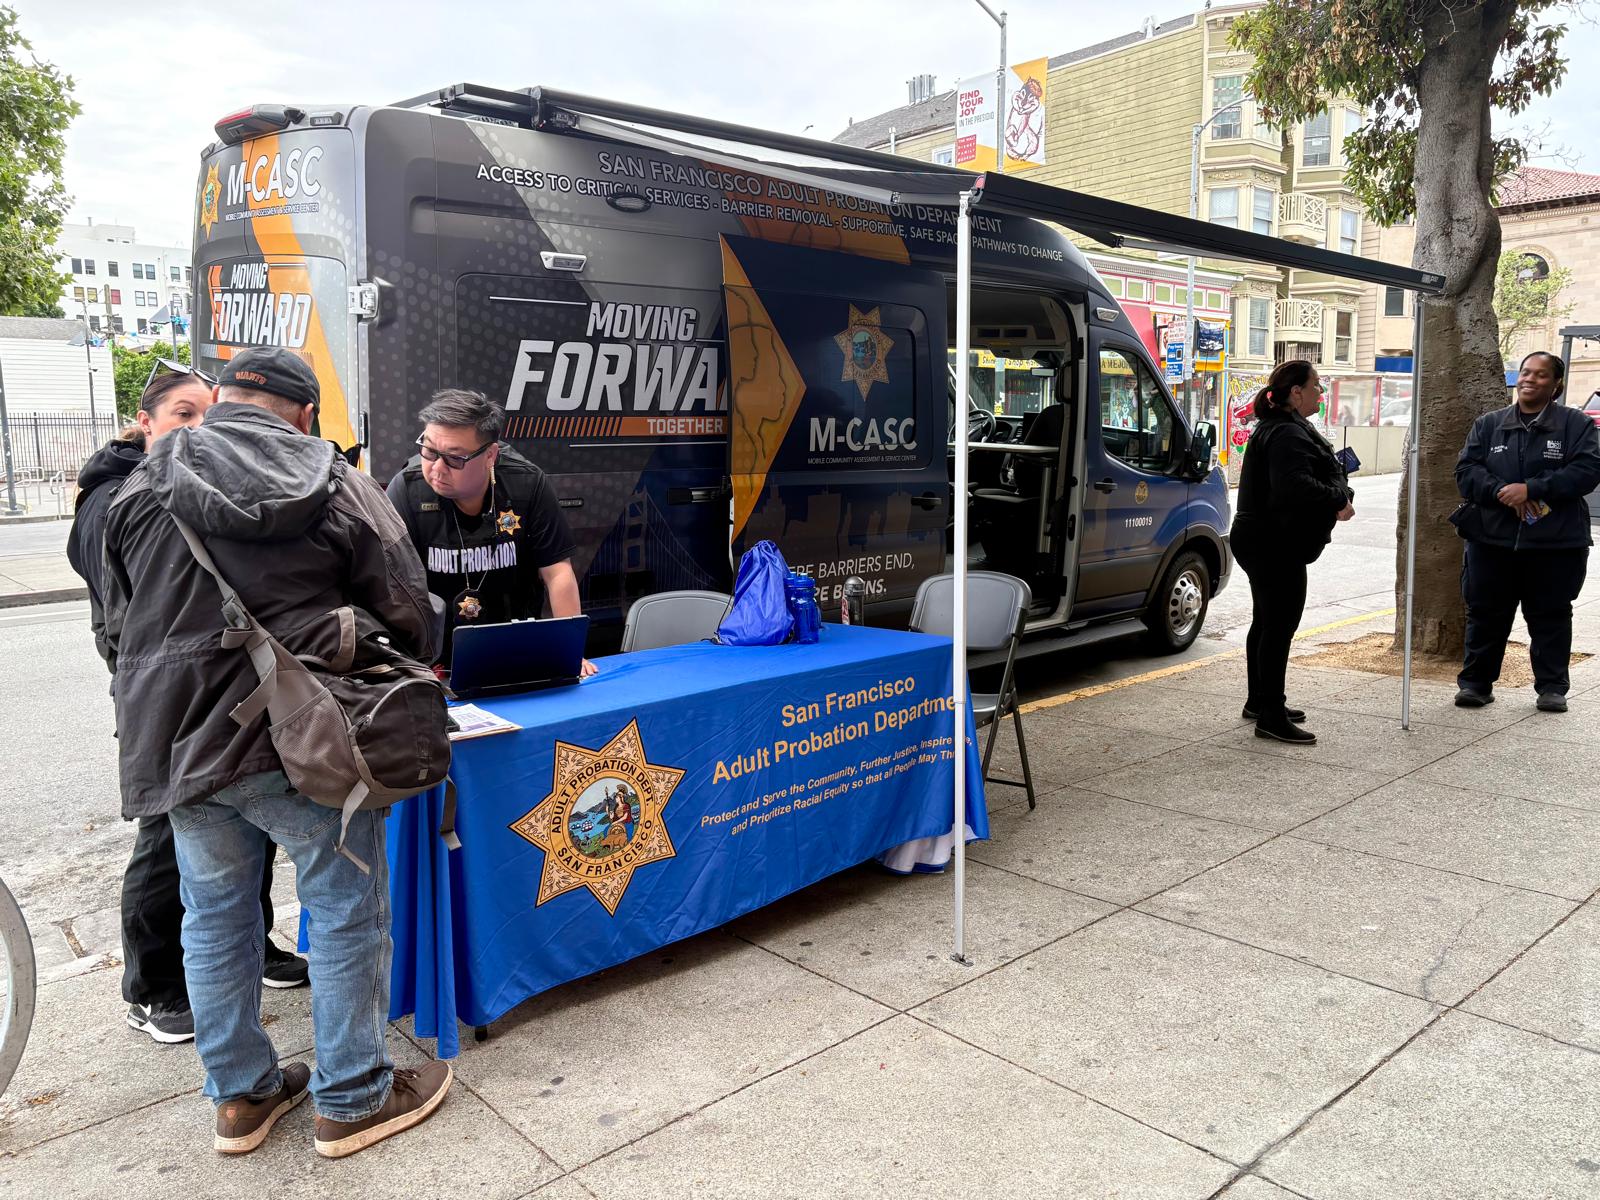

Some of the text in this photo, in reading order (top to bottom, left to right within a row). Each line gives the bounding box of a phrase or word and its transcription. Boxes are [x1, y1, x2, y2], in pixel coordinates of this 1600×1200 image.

[959, 89, 980, 101] FIND
[959, 97, 983, 109] YOUR
[959, 107, 976, 118] JOY
[966, 117, 974, 126] THE
[226, 146, 324, 206] M-CASC
[599, 152, 1002, 233] SAN FRANCISCO ADULT PROBATION DEPARMENT
[477, 163, 544, 188] ACCESS
[547, 173, 572, 192] TO
[645, 187, 709, 209] SERVICES
[721, 198, 773, 219] BARRIER
[777, 207, 833, 227] REMOVAL
[842, 216, 908, 239] SUPPORTIVE,
[910, 226, 934, 242] SAFE
[936, 229, 958, 246] SPAC
[972, 235, 1016, 254] PATHWAYS
[1018, 243, 1030, 256] TO
[1030, 246, 1064, 262] CHANGE
[230, 262, 269, 290] MOVING
[209, 292, 312, 348] FORWARD
[585, 301, 698, 342] MOVING
[504, 339, 728, 411] FORWA
[647, 417, 724, 434] TOGETHER
[809, 416, 918, 452] M-CASC
[1125, 515, 1153, 528] 11100019
[427, 540, 517, 574] ADULT PROBATION
[818, 555, 882, 579] BARRIERS
[885, 552, 915, 571] END,
[781, 676, 916, 727] San Francisco
[712, 694, 956, 785] Adult Probation Departme
[551, 759, 654, 834] ADULT PROBATION DEPT.
[701, 807, 741, 828] Protect
[741, 796, 760, 814] and
[762, 788, 788, 807] Serve
[789, 783, 805, 795] the
[807, 765, 858, 790] Community,
[860, 754, 892, 772] Further
[892, 743, 919, 761] Justice,
[920, 735, 953, 749] Inspire
[731, 818, 749, 836] and
[749, 803, 792, 827] Prioritize
[793, 791, 823, 810] Racial
[823, 781, 850, 800] Equity
[852, 777, 864, 790] so
[865, 771, 883, 785] that
[883, 767, 893, 779] all
[893, 757, 917, 775] People
[918, 752, 938, 764] May
[557, 820, 653, 876] SAN FRANCISCO
